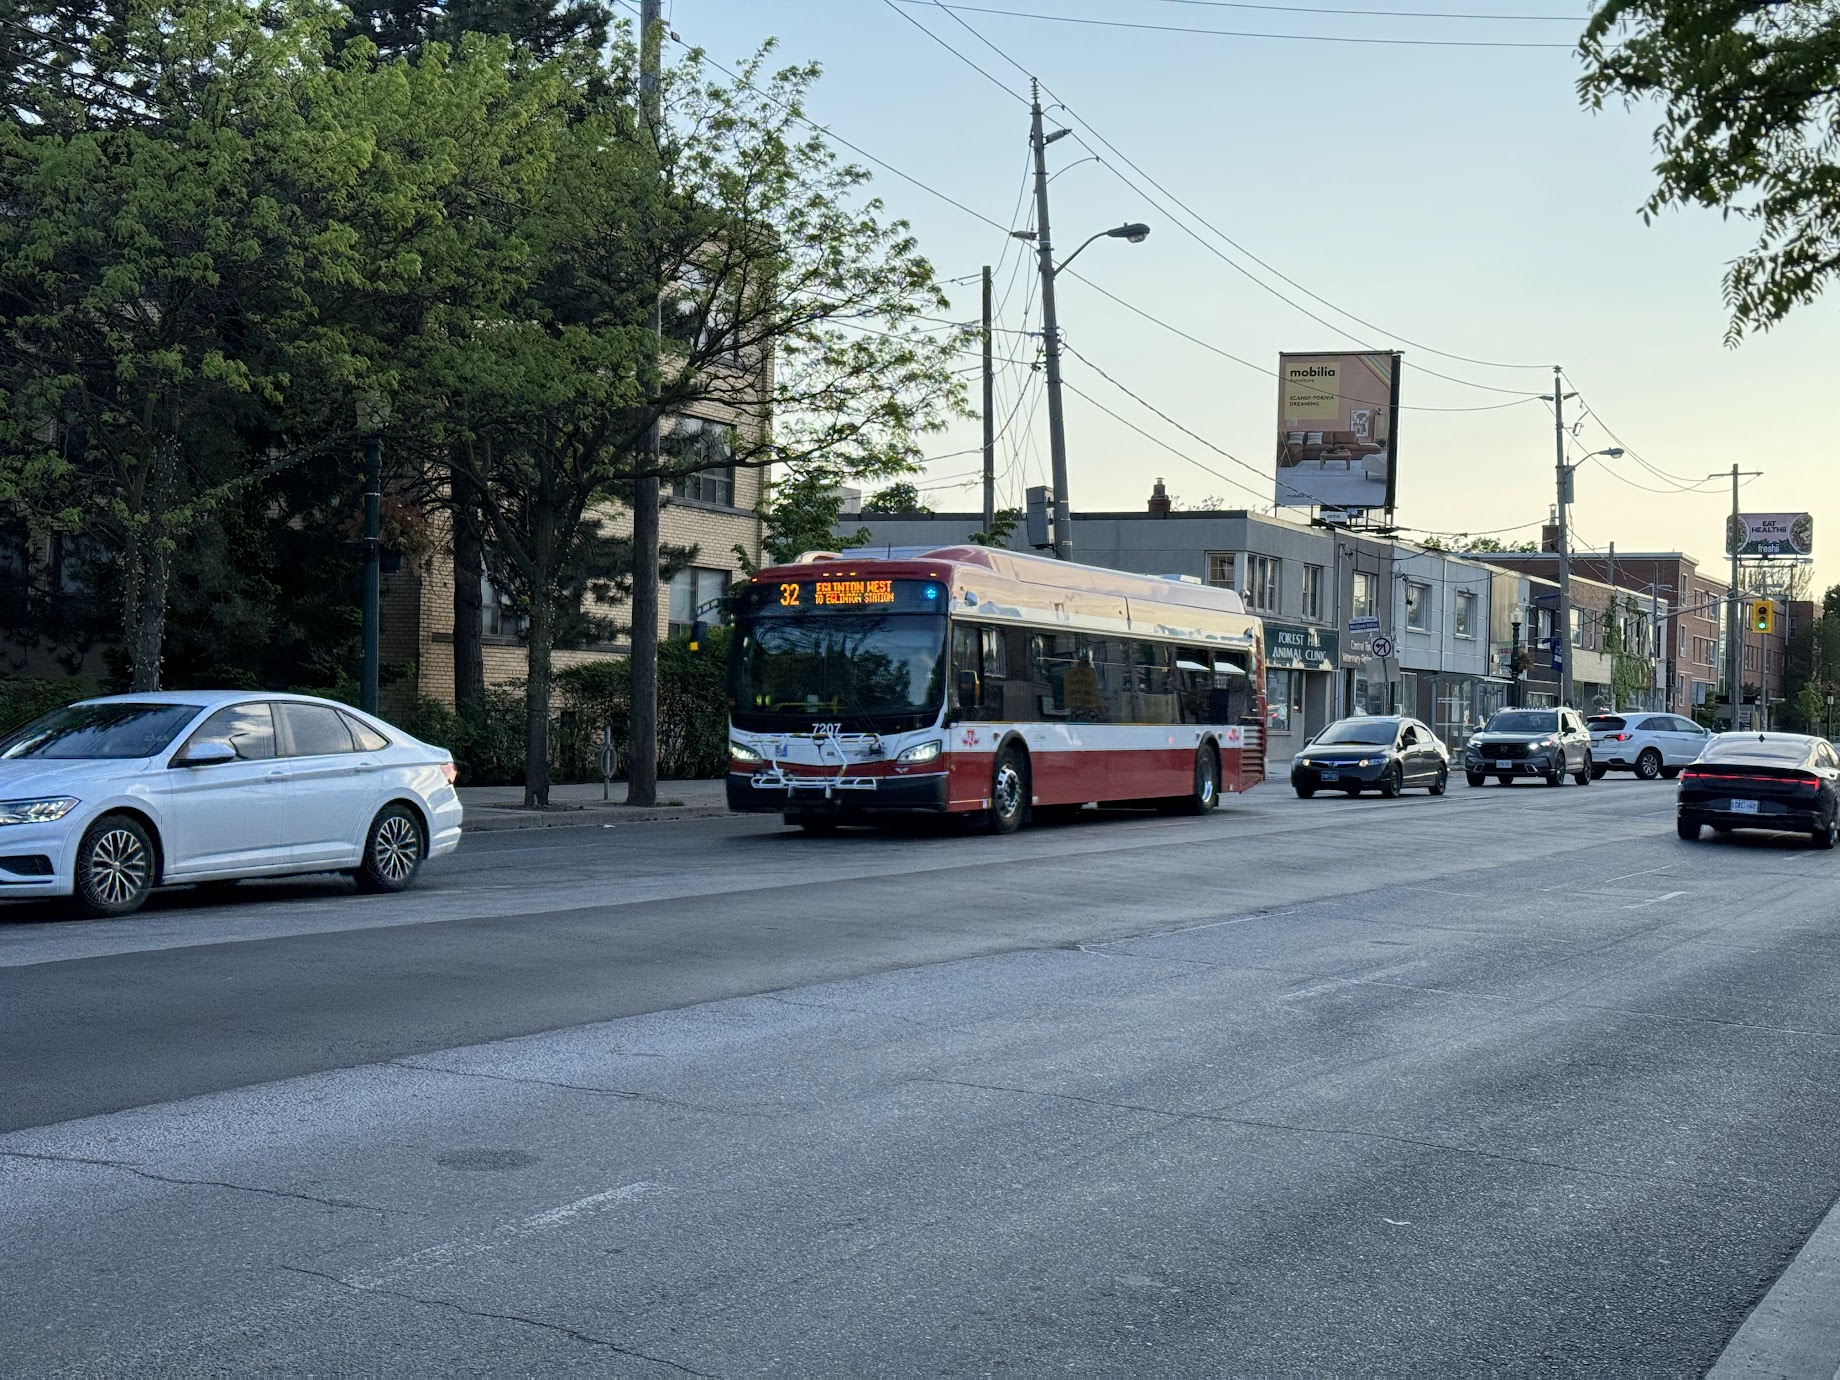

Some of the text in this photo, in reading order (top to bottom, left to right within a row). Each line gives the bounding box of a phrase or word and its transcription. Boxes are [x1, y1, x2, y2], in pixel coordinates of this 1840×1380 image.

[1290, 366, 1335, 377] mobilia
[1758, 544, 1779, 552] freshii
[816, 580, 892, 593] EGLINTON WEST
[780, 583, 800, 606] 32
[815, 592, 894, 604] TO EGLINTON STATION
[1278, 632, 1304, 645] FOREST
[1272, 646, 1326, 662] ANIMAL CLINIC
[812, 723, 841, 736] 7207
